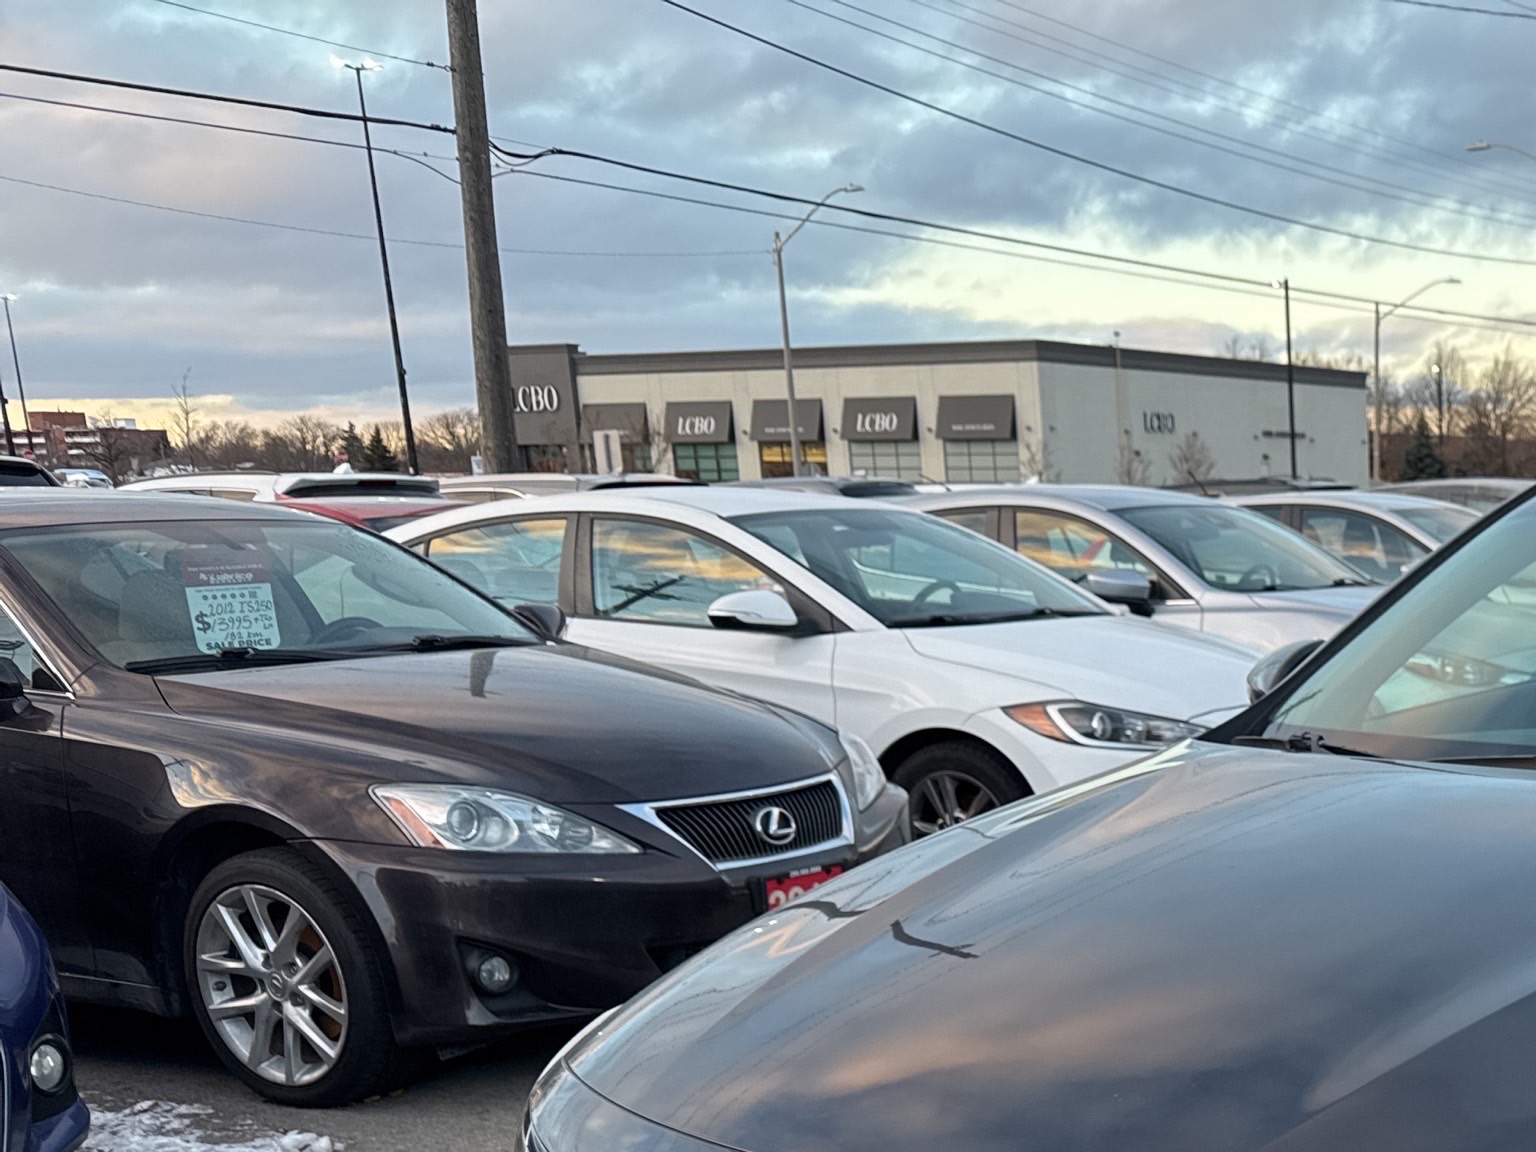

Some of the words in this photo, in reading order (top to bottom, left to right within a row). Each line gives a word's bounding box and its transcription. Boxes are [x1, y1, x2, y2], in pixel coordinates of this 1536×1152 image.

[677, 416, 715, 435] LCBO
[856, 412, 898, 432] LCBO
[1143, 411, 1175, 434] LCBO
[208, 602, 236, 617] 2012
[237, 638, 273, 649] PRICE
